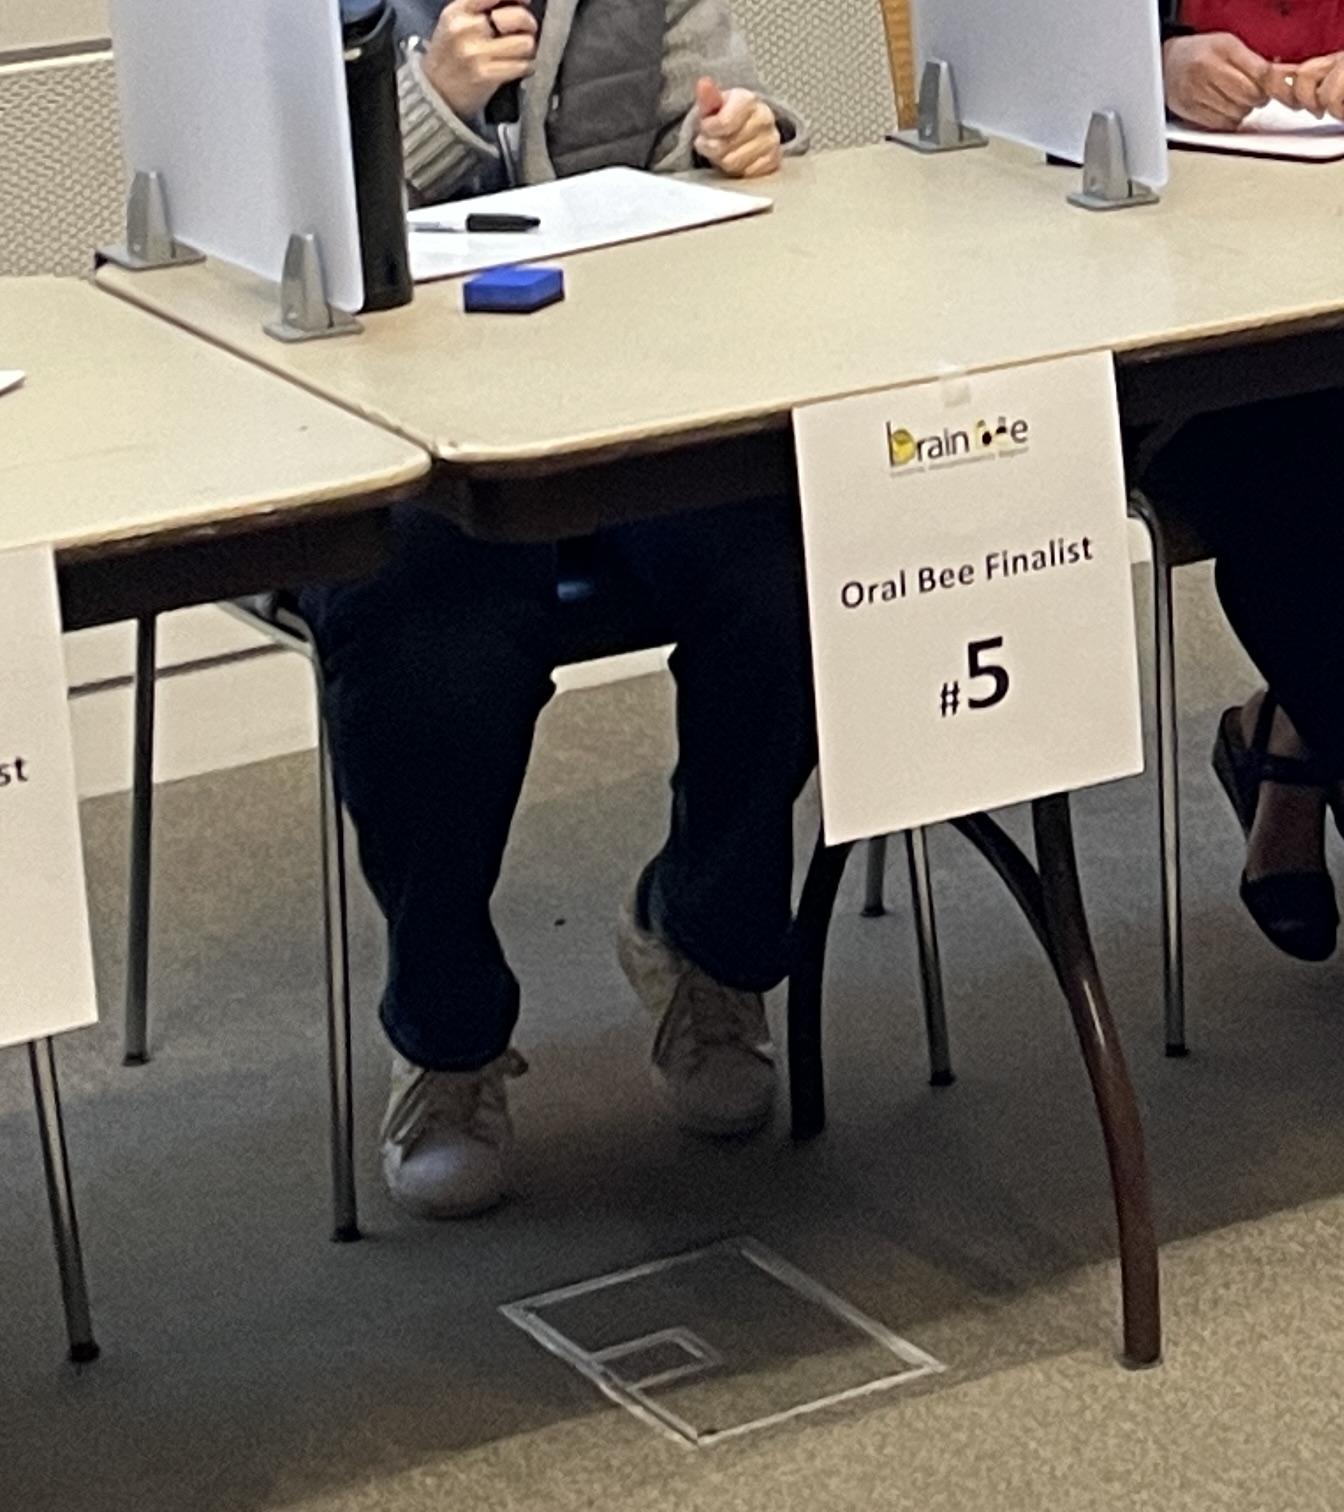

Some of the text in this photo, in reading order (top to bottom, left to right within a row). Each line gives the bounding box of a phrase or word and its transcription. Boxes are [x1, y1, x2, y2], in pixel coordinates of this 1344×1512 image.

[840, 536, 1094, 609] Oral Bee Finalist
[939, 635, 1010, 718] #5
